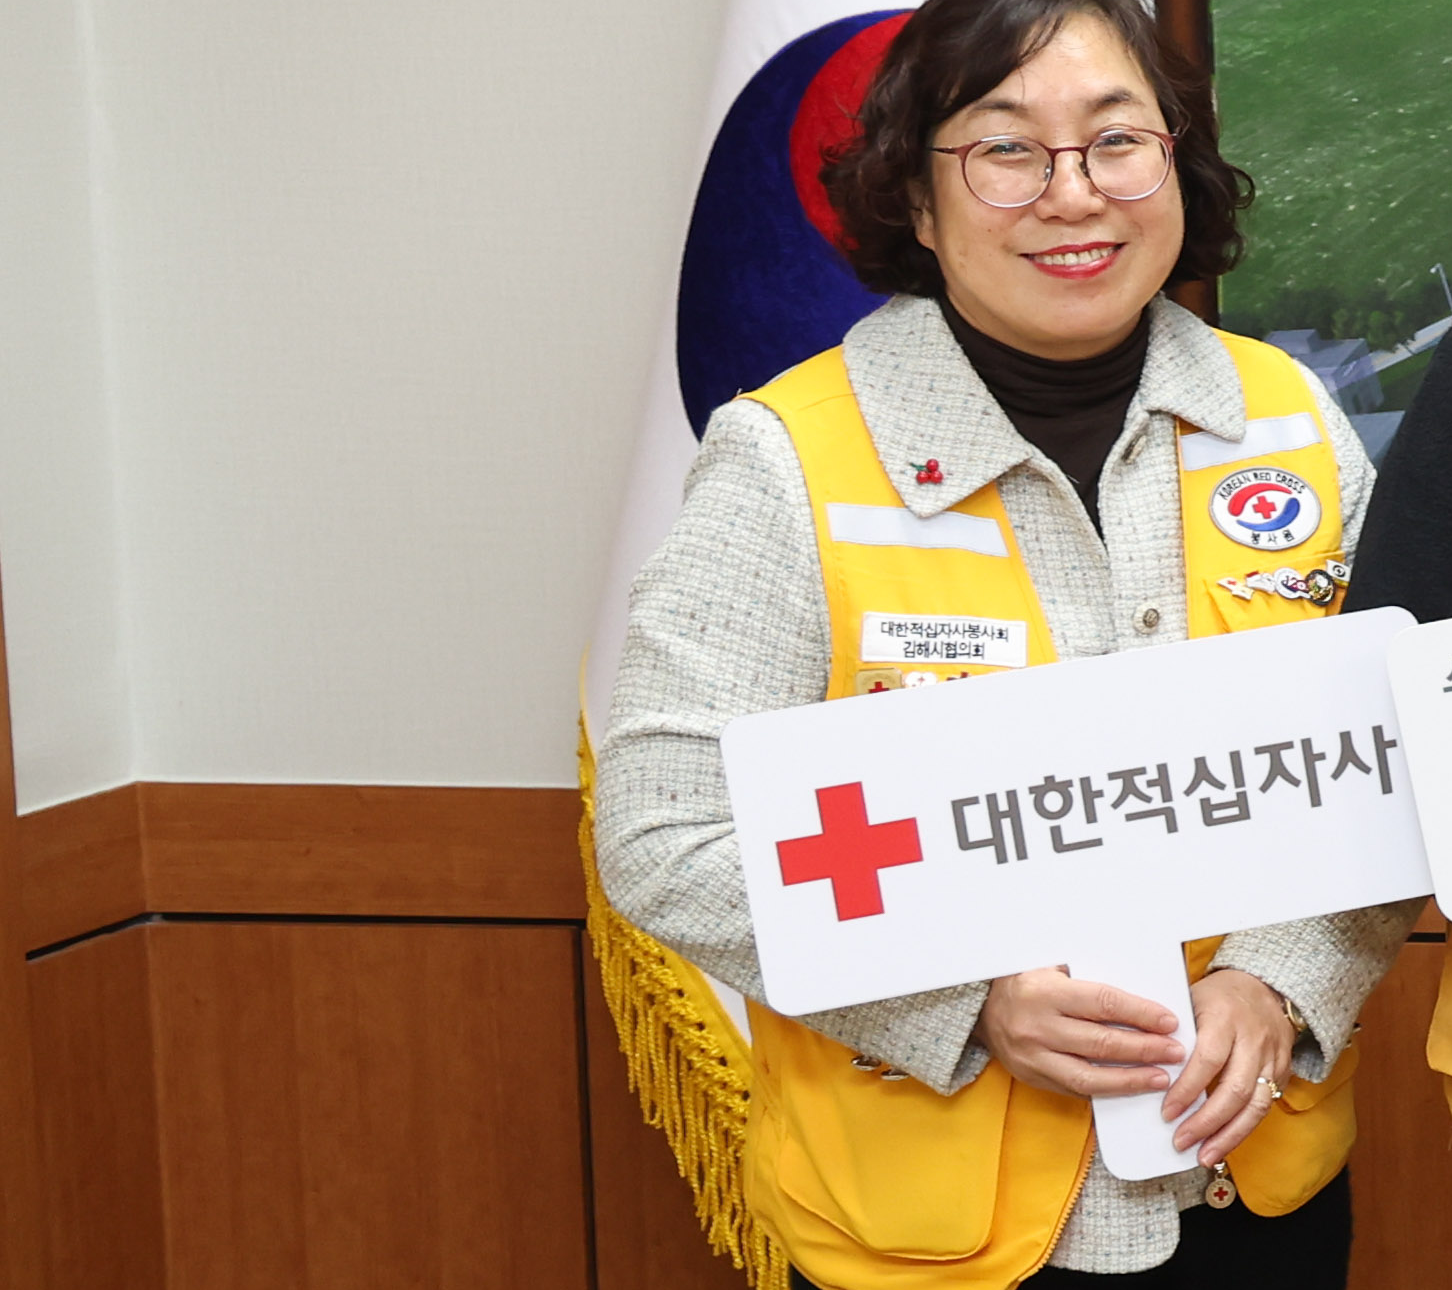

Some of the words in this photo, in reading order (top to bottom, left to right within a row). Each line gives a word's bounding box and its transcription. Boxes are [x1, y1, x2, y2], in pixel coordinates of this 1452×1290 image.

[1217, 474, 1251, 500] KOREAN
[1253, 472, 1271, 482] RED
[1275, 473, 1307, 494] CROSS
[881, 621, 1009, 642] 대한적십자사봉사회
[903, 641, 985, 660] 김해시협의회
[951, 724, 1399, 865] 대한적십자사
